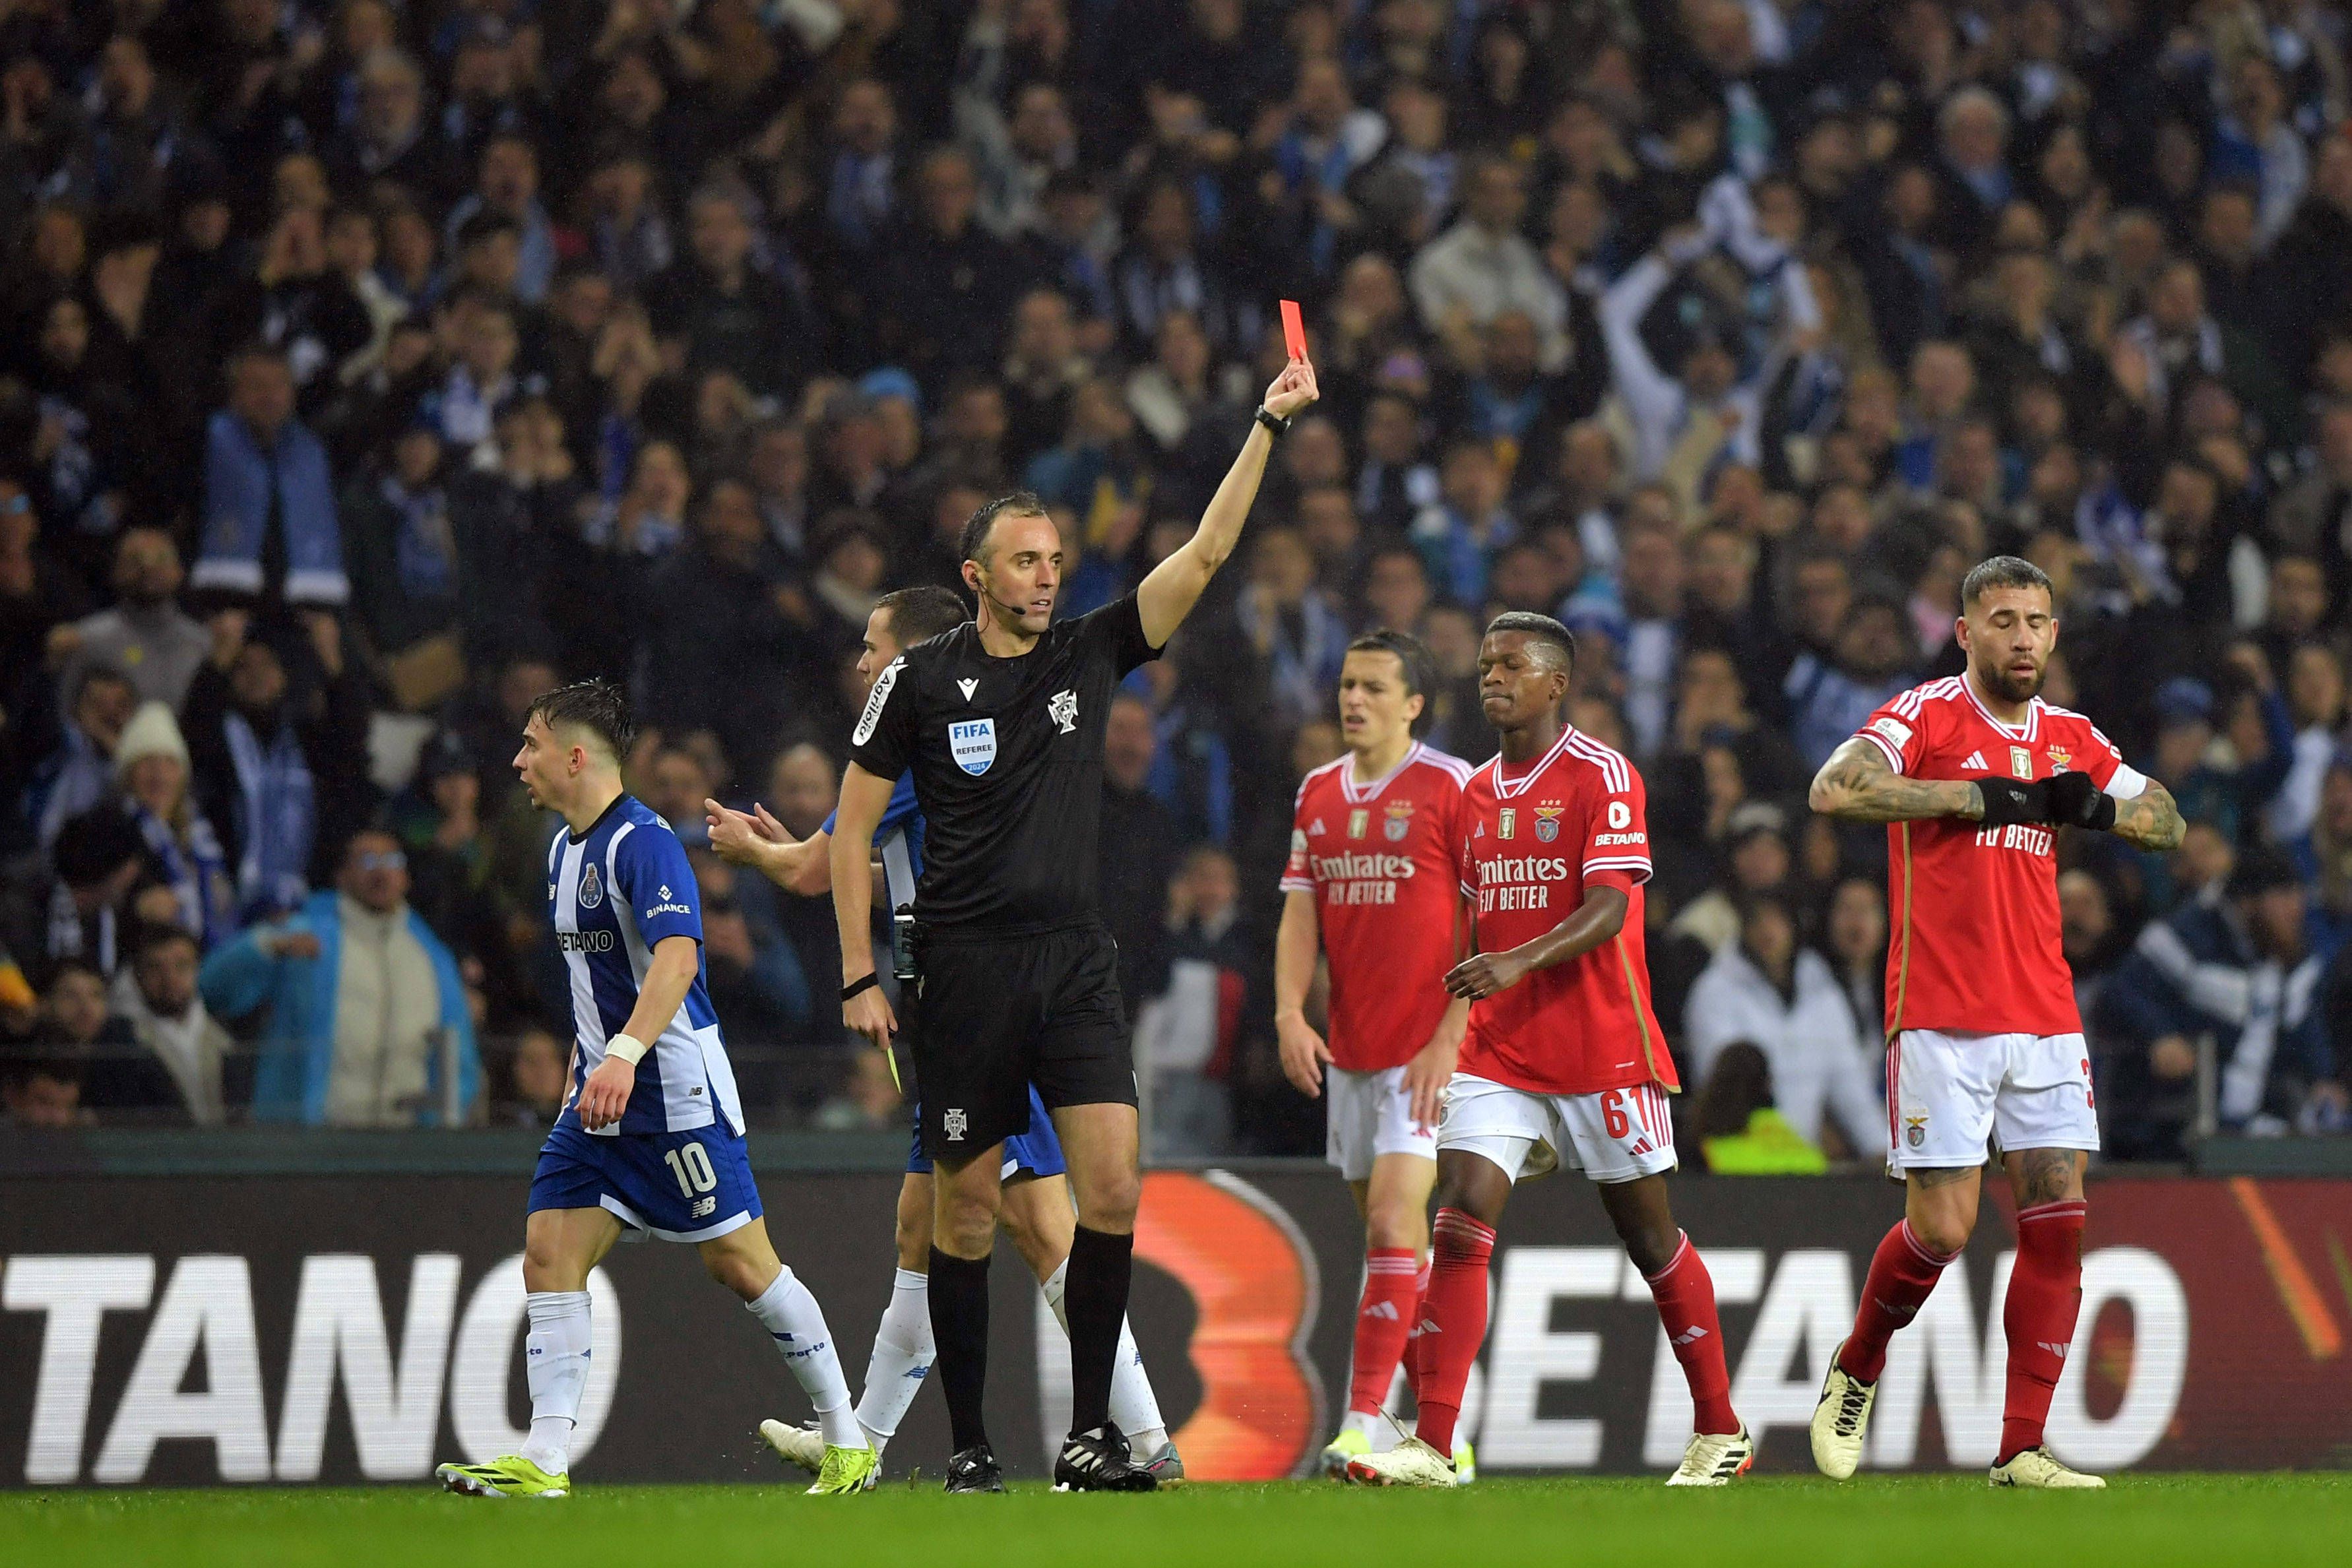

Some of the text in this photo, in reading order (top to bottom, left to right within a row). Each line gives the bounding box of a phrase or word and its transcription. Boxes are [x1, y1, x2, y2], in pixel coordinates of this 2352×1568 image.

[953, 723, 990, 739] FIFA
[956, 744, 992, 755] REFEREE
[1595, 832, 1645, 846] BETANO
[1975, 823, 2052, 856] FLY BETTER
[1310, 850, 1415, 881] Emirates
[647, 903, 691, 919] BINANCE
[1479, 885, 1547, 912] FLY BETTER
[1600, 1087, 1650, 1139] 61
[664, 1142, 716, 1198] 10
[2, 1253, 621, 1483] TANO
